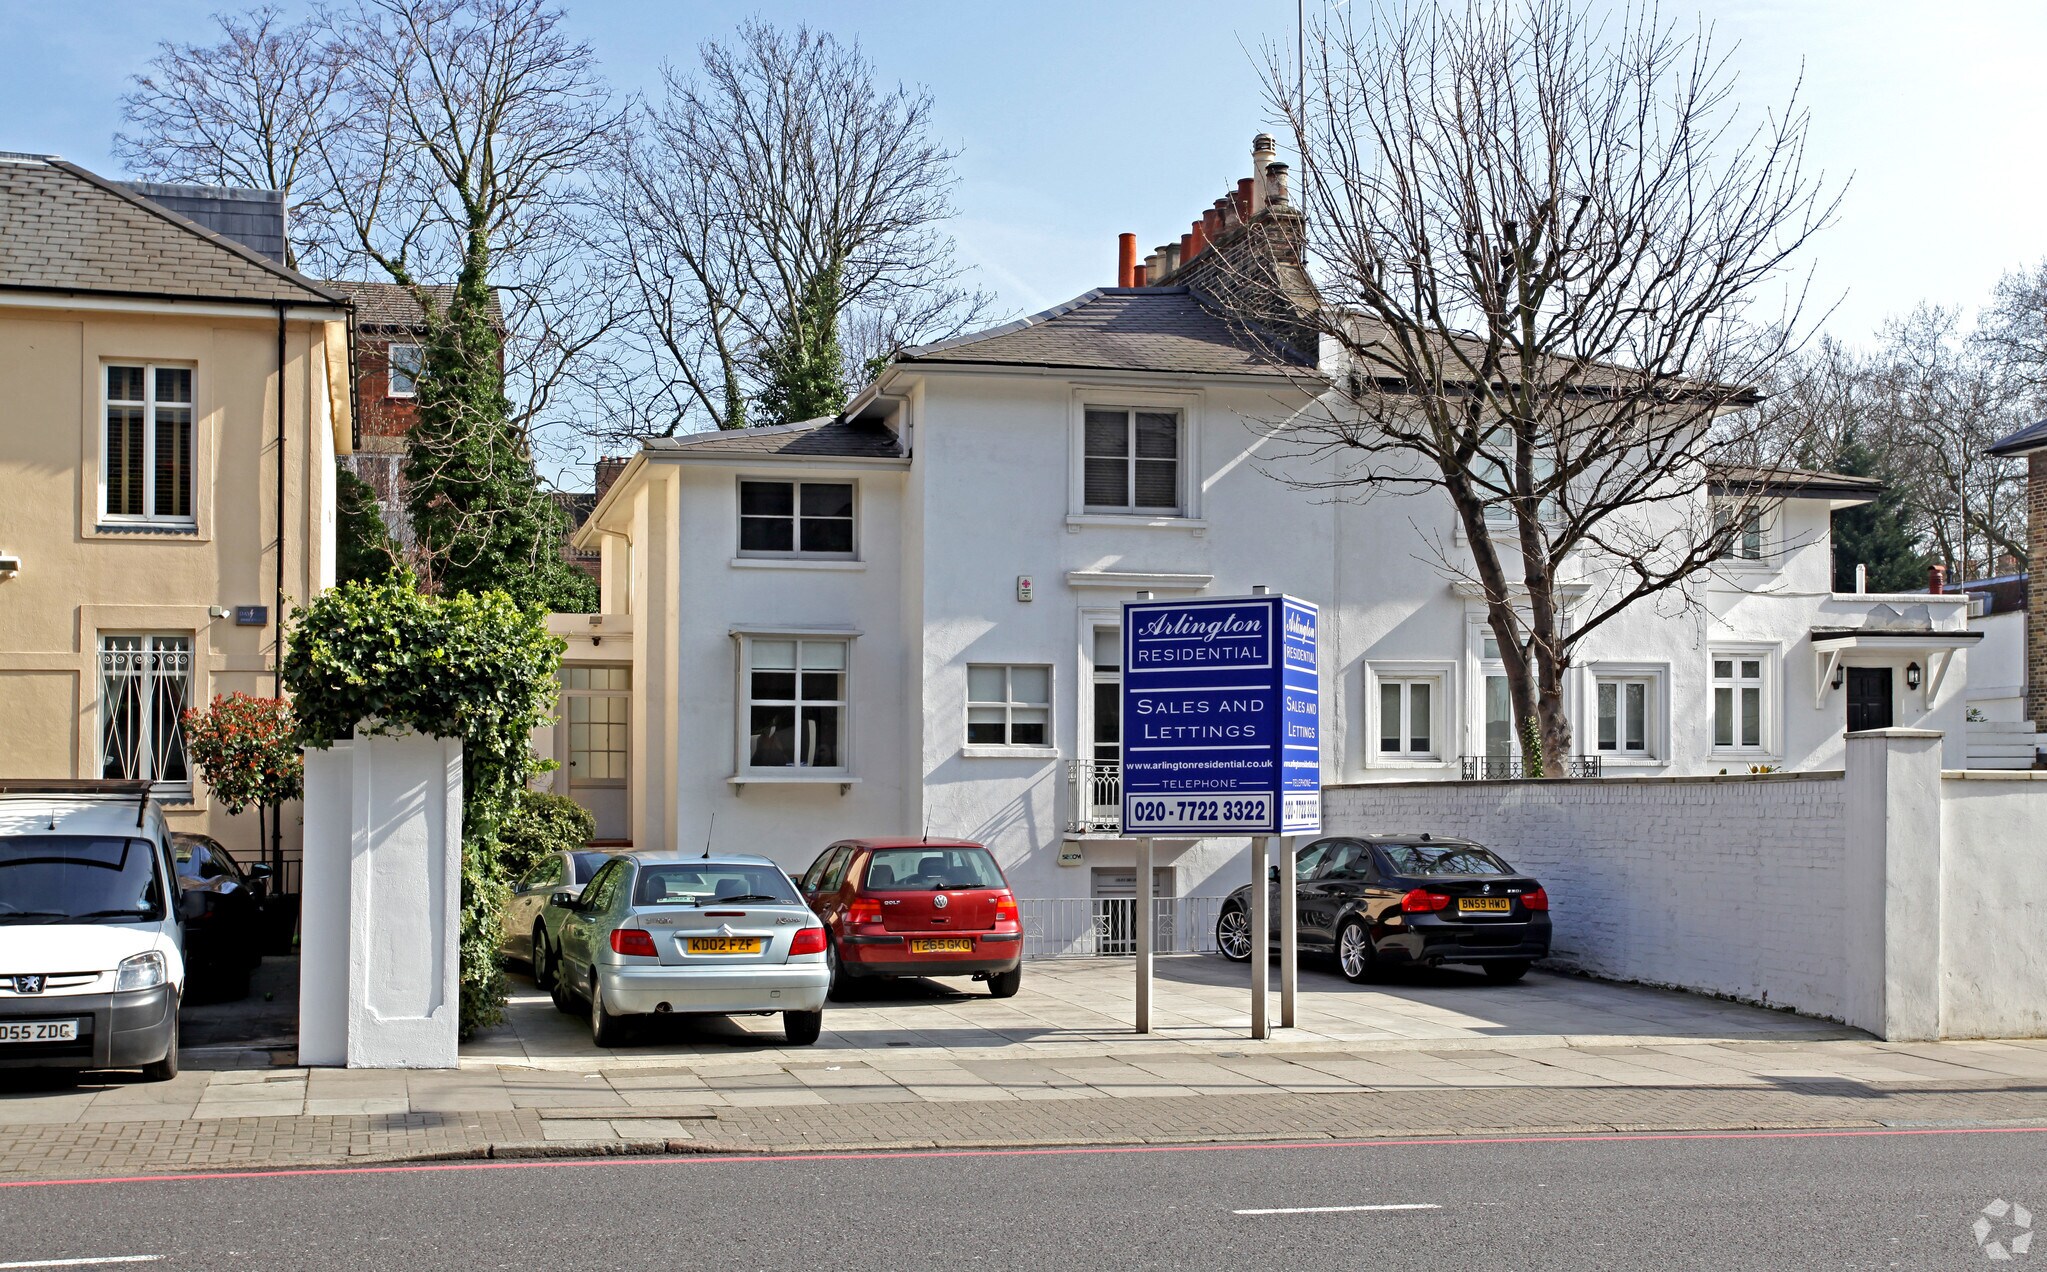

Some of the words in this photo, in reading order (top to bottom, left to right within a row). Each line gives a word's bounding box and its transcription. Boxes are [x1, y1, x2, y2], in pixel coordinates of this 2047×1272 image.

[1138, 613, 1262, 643] Arlington
[1138, 646, 1262, 662] RESIDENTIAL
[1286, 646, 1316, 664] RESIDENTIAL
[1137, 699, 1210, 715] SALES
[1219, 700, 1264, 713] AND
[1286, 696, 1306, 714] SALES
[1306, 701, 1317, 715] AND
[1144, 723, 1256, 739] LETTINGS
[1288, 721, 1315, 739] LETTINGS
[1126, 759, 1273, 772] www.arlingtonresidential.co.uk
[1162, 779, 1237, 789] TELEPHONE
[1223, 800, 1265, 821] 3322
[1462, 899, 1487, 909] BN59
[1488, 899, 1507, 909] HWO
[692, 937, 726, 951] KD02
[729, 938, 754, 951] FZF
[913, 939, 945, 951] T265
[947, 938, 970, 950] GKO
